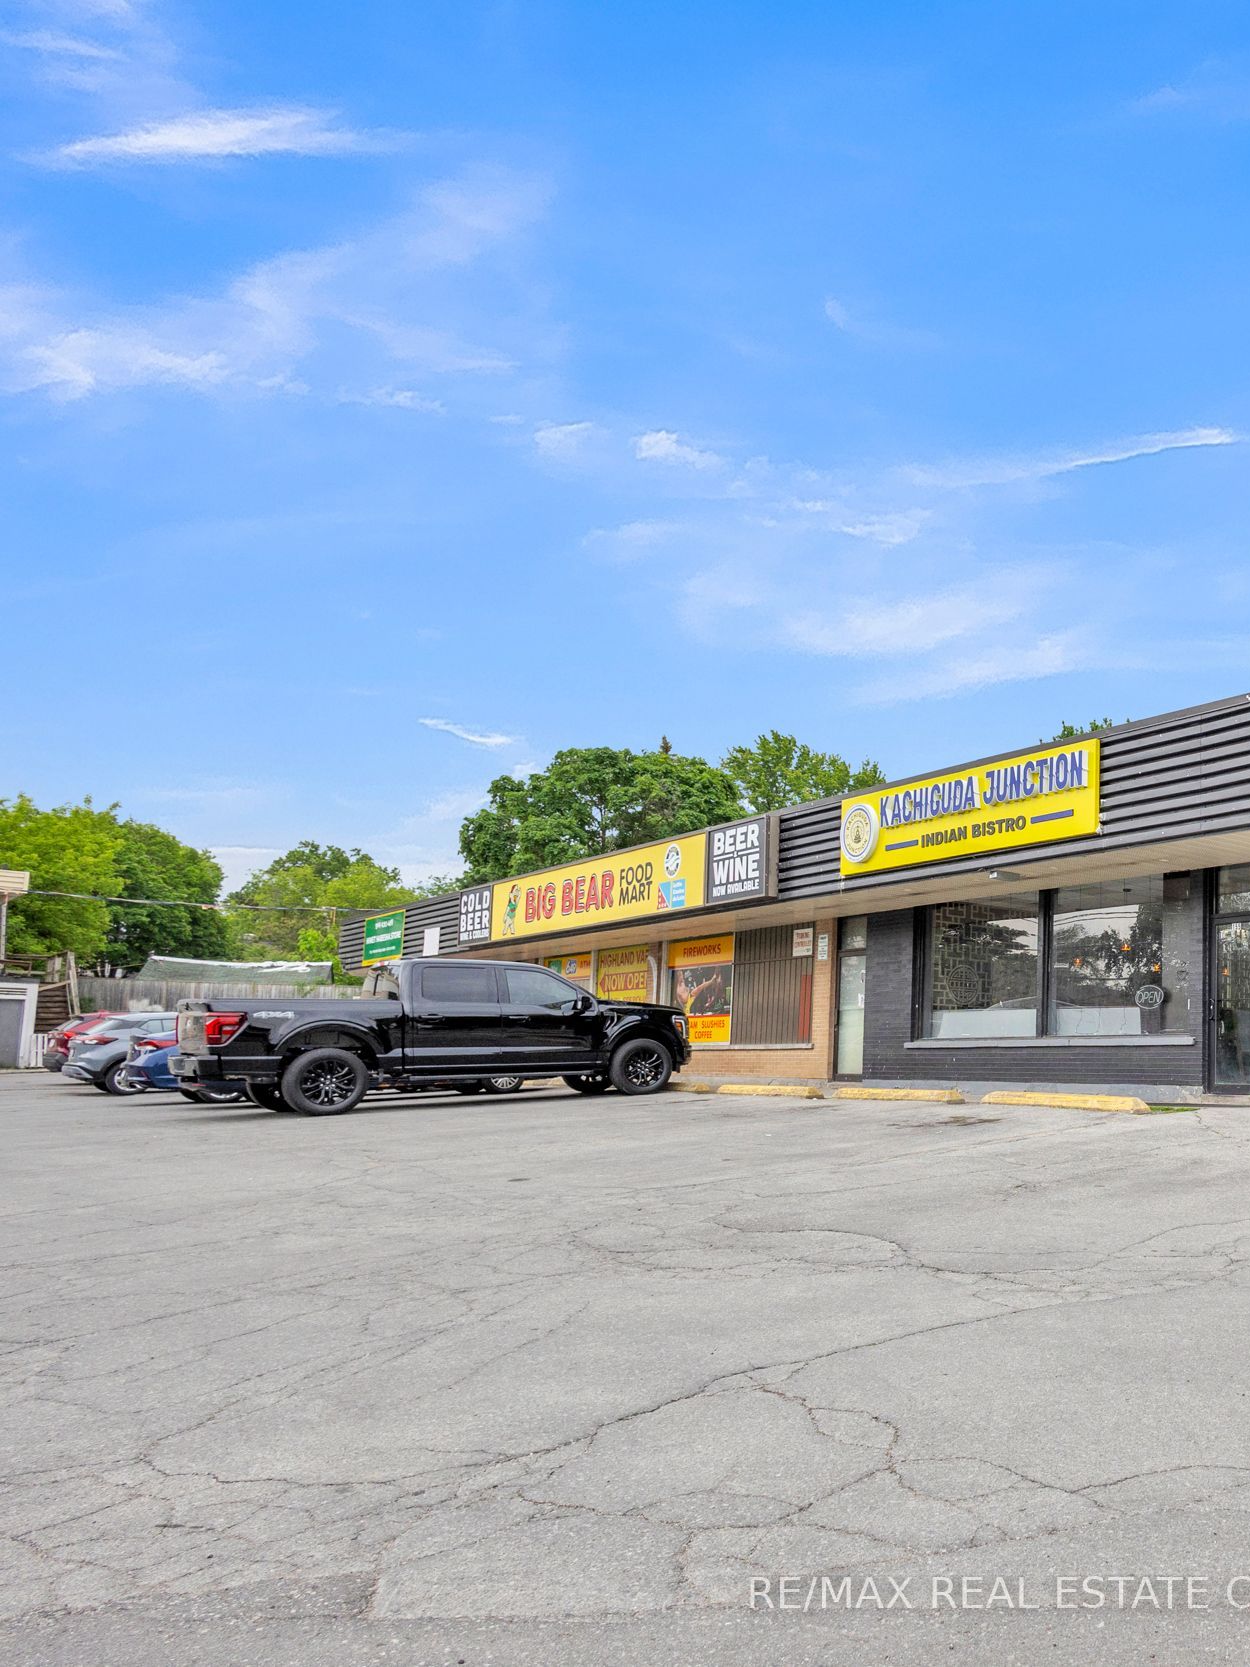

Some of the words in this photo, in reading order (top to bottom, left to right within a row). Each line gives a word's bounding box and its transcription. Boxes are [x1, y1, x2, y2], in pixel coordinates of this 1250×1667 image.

[881, 775, 979, 828] KACHIGUDA
[983, 750, 1087, 806] JUNCTION
[714, 824, 759, 855] BEER
[921, 826, 967, 848] INDIAN
[972, 816, 1026, 837] BISTRO
[619, 862, 653, 887] FOOD
[713, 853, 759, 884] WINE
[525, 882, 556, 923] BIG
[562, 870, 614, 916] BEAR
[619, 881, 652, 906] MART
[713, 885, 726, 897] NOW
[727, 879, 760, 895] AVAILABLE
[461, 891, 490, 914] COLD
[460, 910, 489, 932] BEER
[600, 951, 634, 969] HIGHLAND
[683, 943, 721, 958] FIREWORKS
[605, 973, 626, 992] NOW
[694, 1030, 712, 1039] COFFEE
[701, 1019, 725, 1029] SLUSHIES
